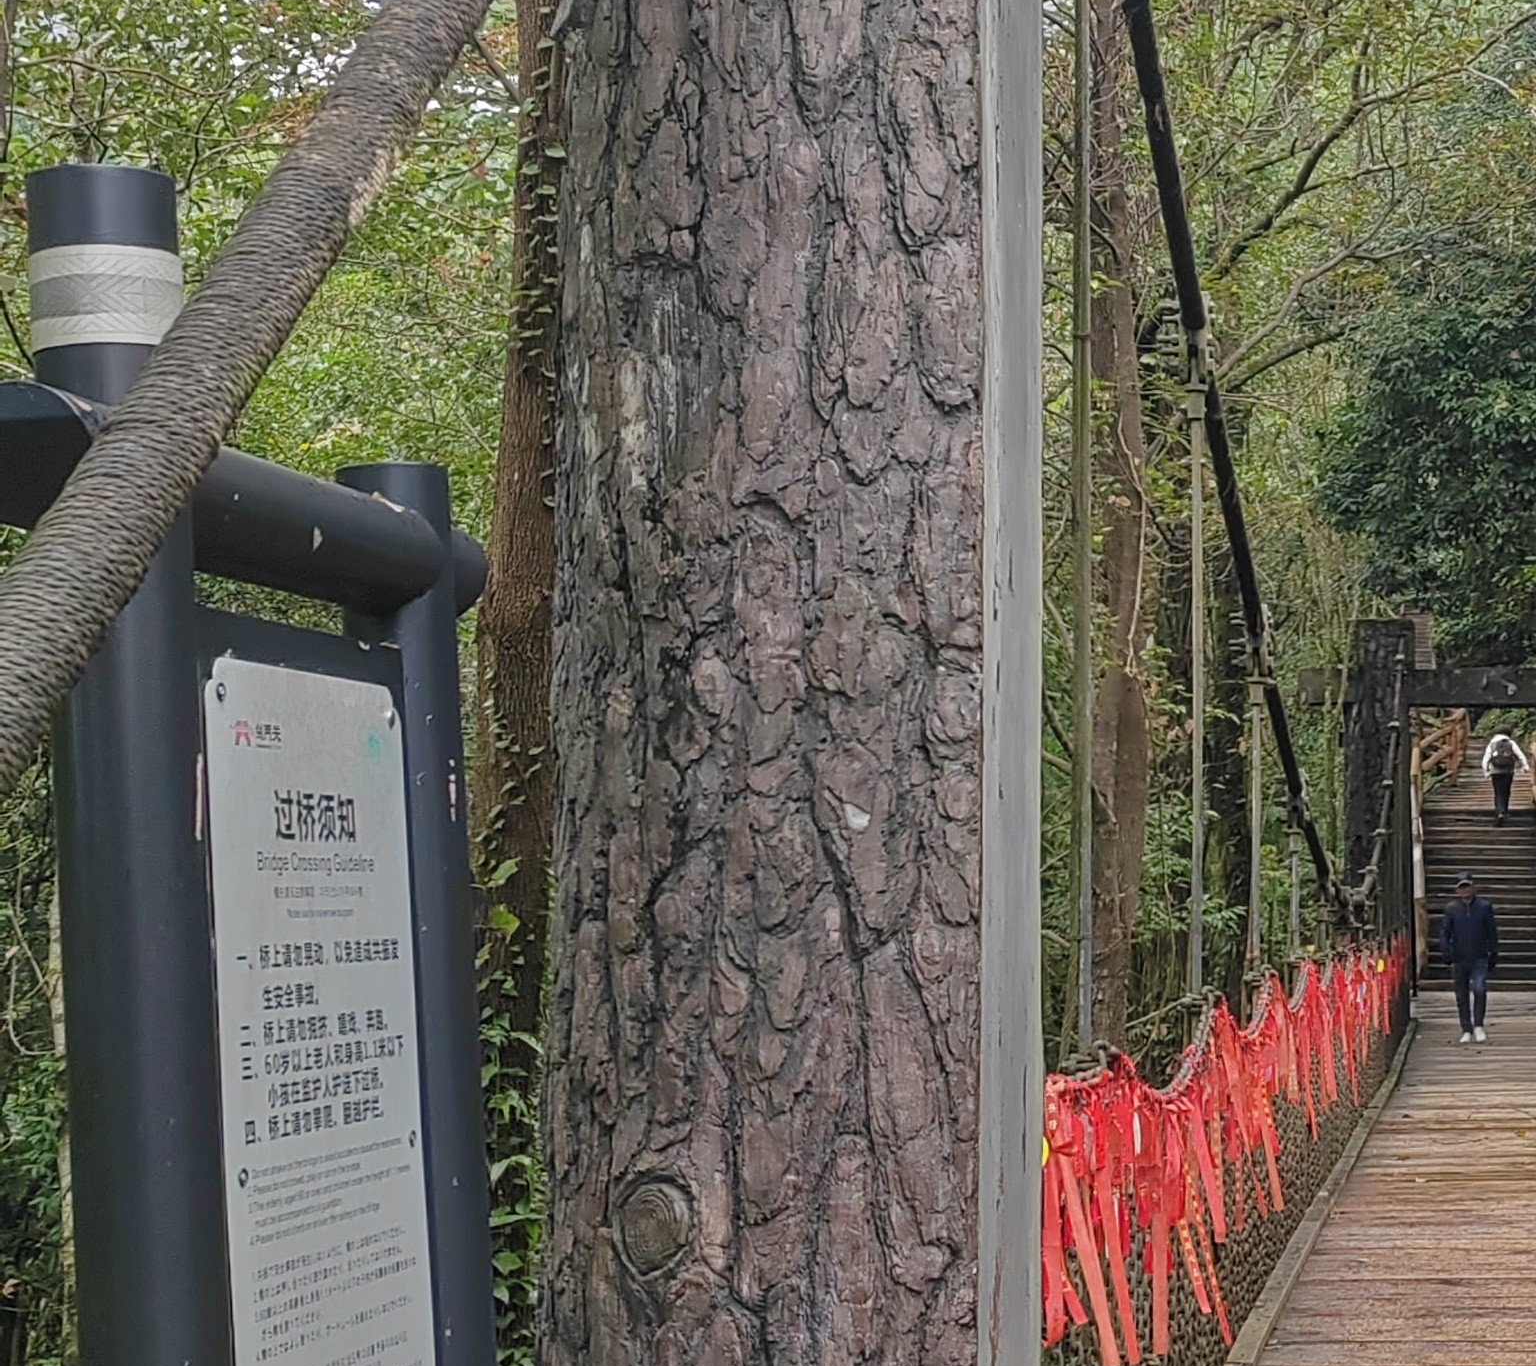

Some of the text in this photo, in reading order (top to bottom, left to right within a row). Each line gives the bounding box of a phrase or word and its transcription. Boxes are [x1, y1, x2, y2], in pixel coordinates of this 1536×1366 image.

[274, 789, 356, 843] 过桥须知
[257, 850, 289, 876] Bridge
[291, 851, 332, 876] Crossing
